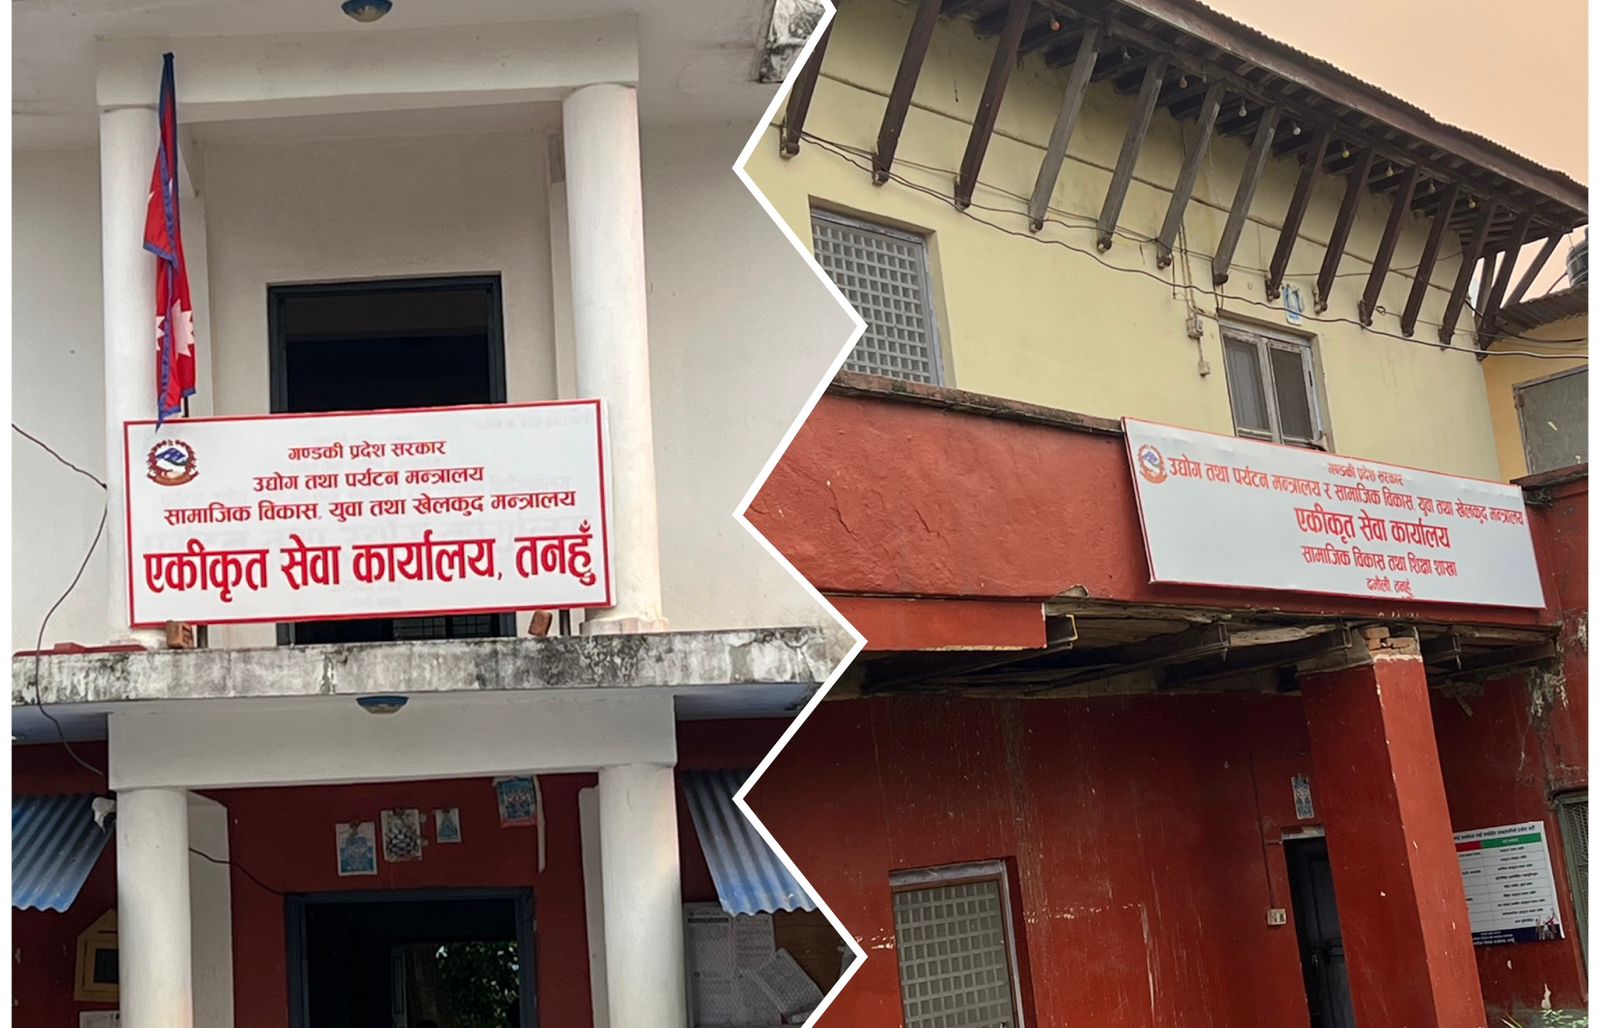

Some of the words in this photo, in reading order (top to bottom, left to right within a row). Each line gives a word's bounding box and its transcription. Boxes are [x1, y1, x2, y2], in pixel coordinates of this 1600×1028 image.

[288, 441, 344, 461] गण्डकी
[349, 440, 386, 460] प्रदेश
[390, 440, 447, 458] सरकार
[253, 471, 300, 492] उद्योग
[304, 473, 339, 491] तथा
[345, 467, 399, 488] पर्यटन
[404, 466, 485, 486] मन्त्रालय
[1167, 453, 1202, 479] उद्योग
[1204, 463, 1231, 484] तथा
[1232, 465, 1270, 490] पर्यटन
[1271, 474, 1322, 497] मन्त्रालय
[1323, 482, 1333, 500] र
[1333, 482, 1380, 506] सामाजिक
[1416, 496, 1435, 517] युवा
[1435, 499, 1454, 516] तथा
[1455, 498, 1488, 525] खेलकुद
[1488, 506, 1525, 526] मन्त्रालय
[163, 501, 252, 526] सामाजिक
[328, 500, 364, 523] युवा
[369, 499, 406, 517] तथा
[412, 492, 485, 517] खेलकुद
[490, 490, 577, 510] मन्त्रालय
[1293, 502, 1356, 544] एकीकृत
[1357, 508, 1388, 542] सेवा
[1389, 517, 1451, 549] कार्यालय
[142, 537, 270, 603] एकीकृत
[279, 533, 342, 591] सेवा
[351, 529, 503, 584] कार्यालय,
[513, 519, 597, 587] तनहुँ
[1300, 542, 1351, 566] सामाजिक
[1351, 545, 1386, 571] विकास
[1386, 554, 1408, 572] तथा
[1407, 551, 1433, 576] शिक्षा
[1433, 558, 1459, 577] शाखा
